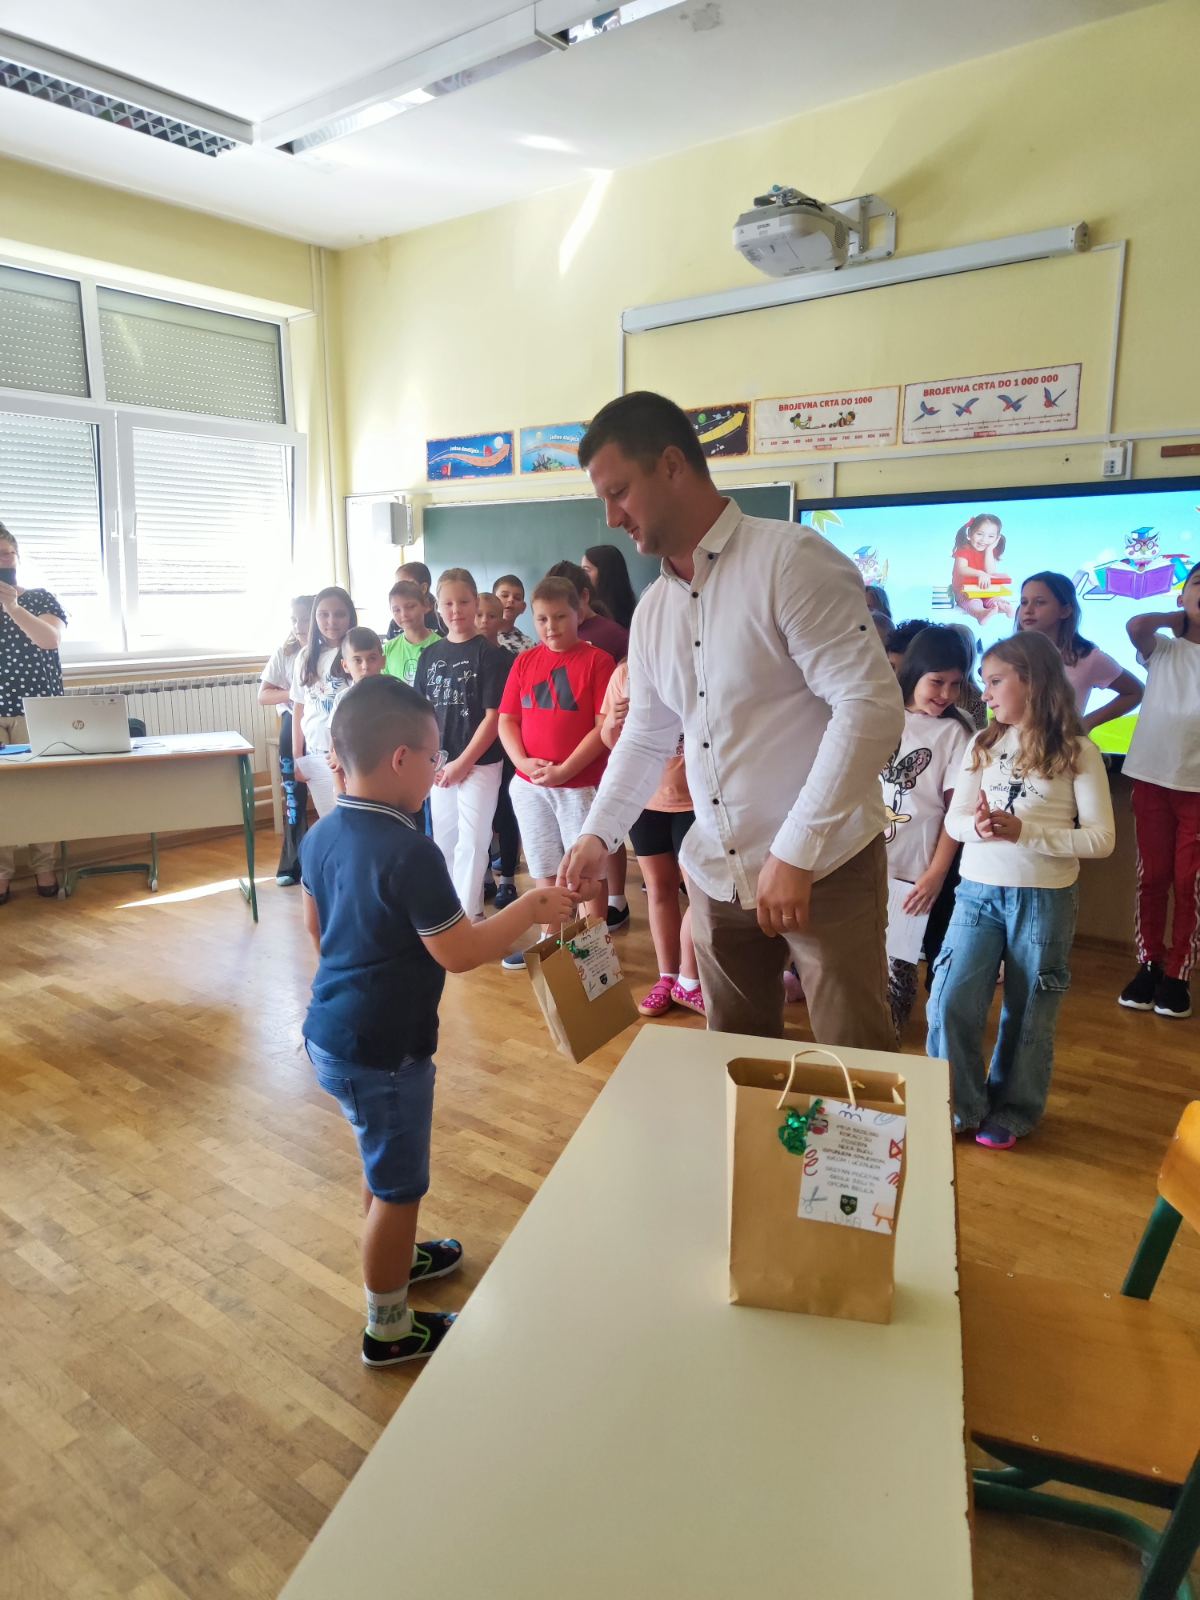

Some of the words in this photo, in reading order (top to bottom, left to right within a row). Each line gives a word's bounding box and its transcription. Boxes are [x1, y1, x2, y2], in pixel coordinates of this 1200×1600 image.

[923, 384, 970, 397] BROJEVNA
[972, 381, 996, 392] CRTA
[998, 379, 1012, 388] DO
[1021, 376, 1039, 386] 000
[1041, 374, 1059, 384] 000
[779, 402, 818, 412] BROJEVNA
[820, 400, 840, 408] CRTA
[854, 396, 873, 405] 1000
